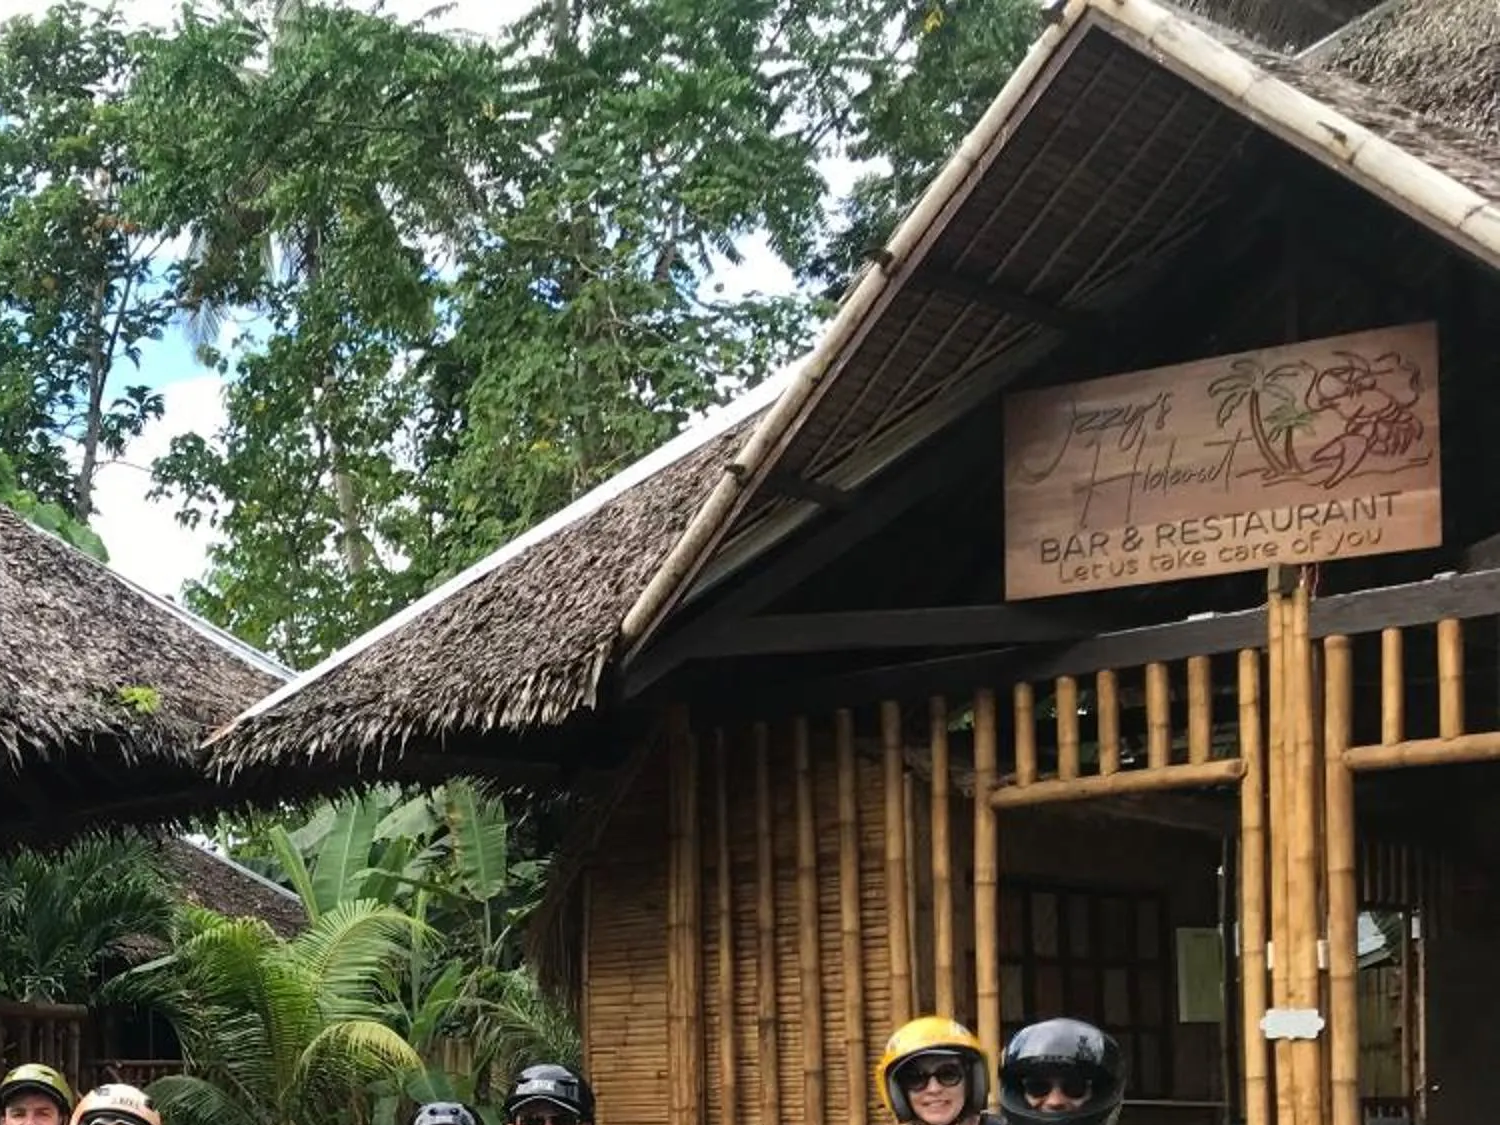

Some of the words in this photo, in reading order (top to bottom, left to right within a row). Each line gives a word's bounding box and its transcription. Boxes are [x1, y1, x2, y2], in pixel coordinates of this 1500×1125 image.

[1040, 533, 1110, 565] BAR
[1121, 527, 1145, 551] &
[1155, 490, 1403, 549] RESTAURANT
[1058, 561, 1104, 584] Let
[1109, 558, 1139, 576] us
[1149, 548, 1207, 573] take
[1219, 541, 1278, 563] care
[1291, 530, 1319, 555] of
[1327, 526, 1383, 556] you
